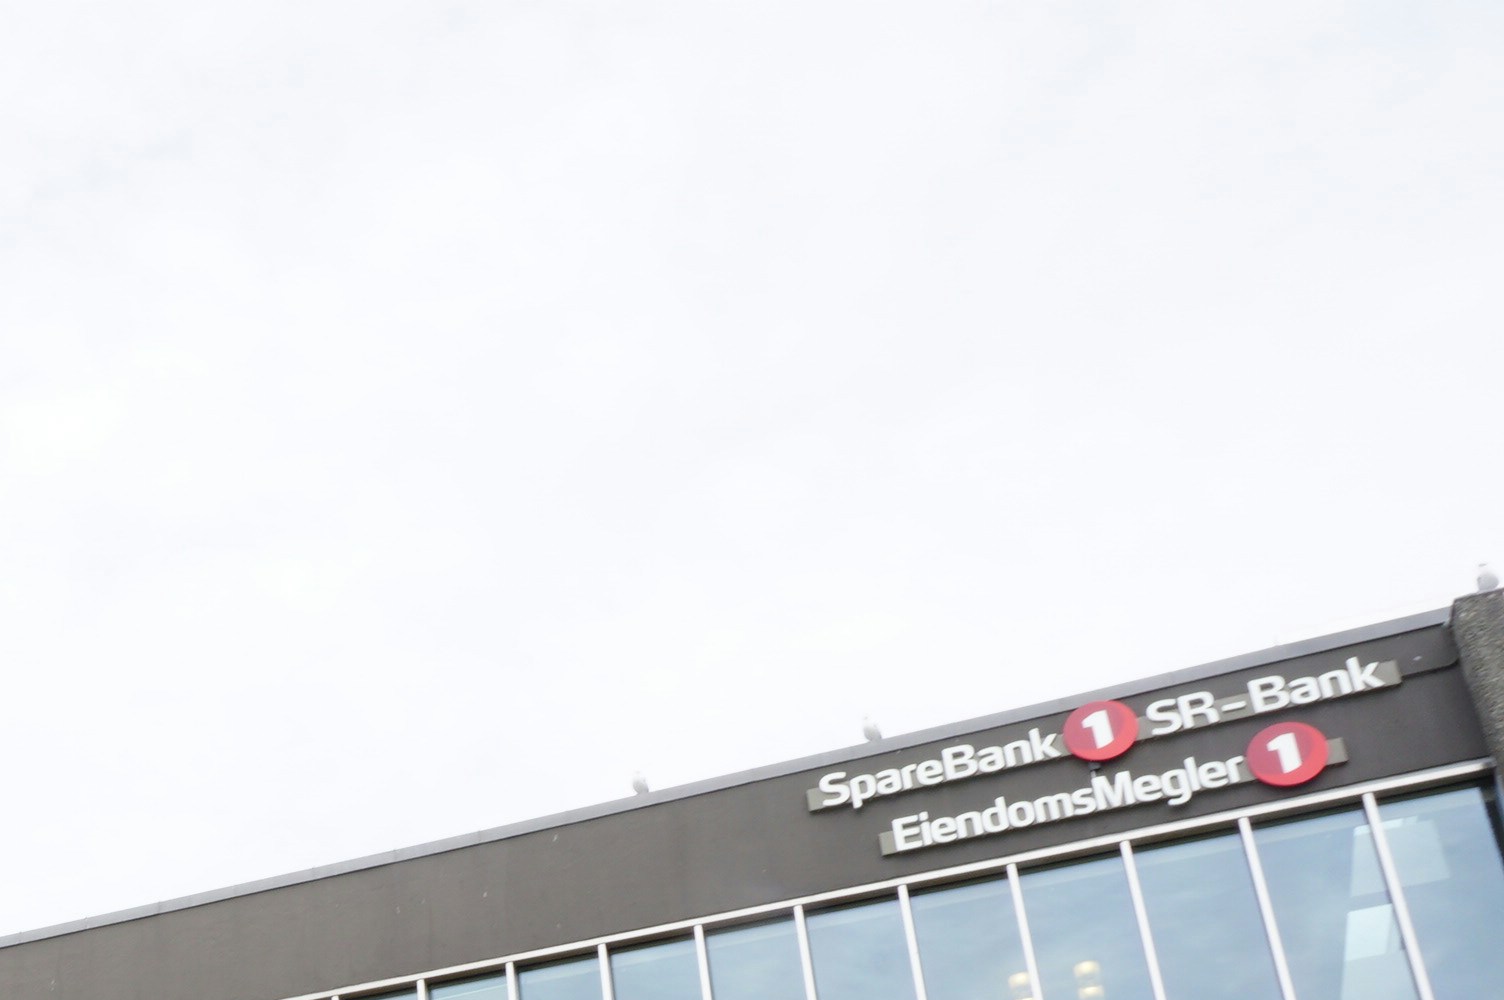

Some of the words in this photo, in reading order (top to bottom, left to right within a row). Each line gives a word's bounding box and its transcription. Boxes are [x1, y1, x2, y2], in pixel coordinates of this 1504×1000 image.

[818, 726, 1060, 809] SpareBank
[1080, 710, 1117, 749] 1
[1144, 656, 1388, 738] SR-Bank
[890, 752, 1245, 853] EiendomsMegler
[1265, 731, 1301, 774] 1
